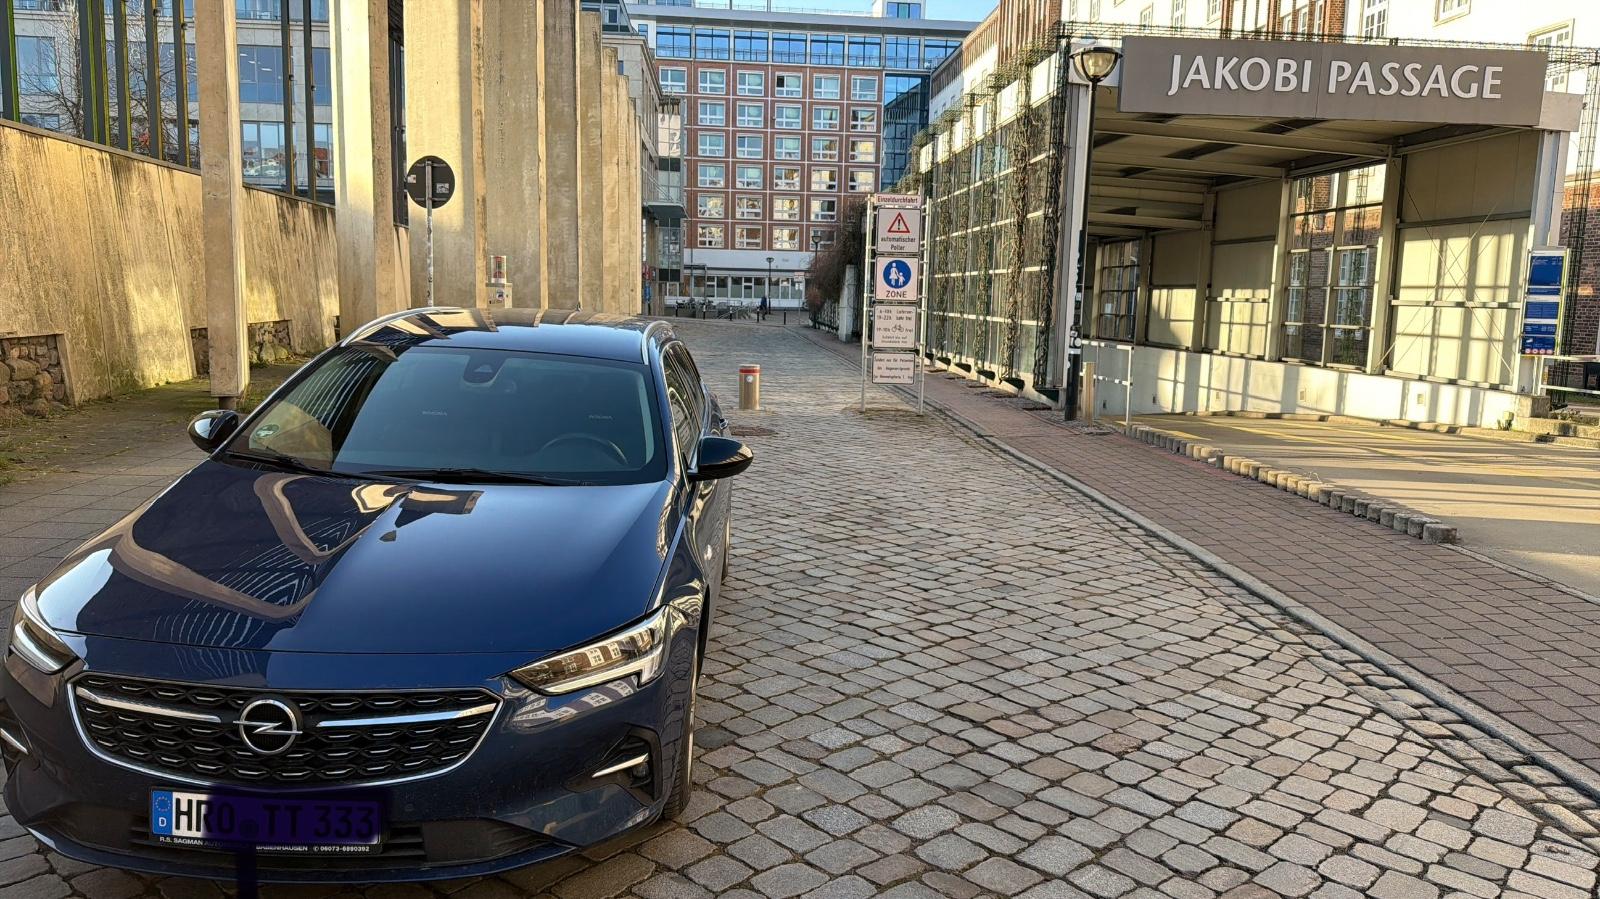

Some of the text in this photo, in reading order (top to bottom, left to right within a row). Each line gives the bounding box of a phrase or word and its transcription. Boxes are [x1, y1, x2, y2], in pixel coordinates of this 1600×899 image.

[1168, 54, 1504, 99] JAKOBI PASSAGE
[877, 195, 918, 203] Einzeldurchfahrt
[880, 235, 916, 243] automatischer
[885, 290, 908, 299] ZONE
[158, 817, 167, 827] D
[173, 838, 204, 846] SAGMAN
